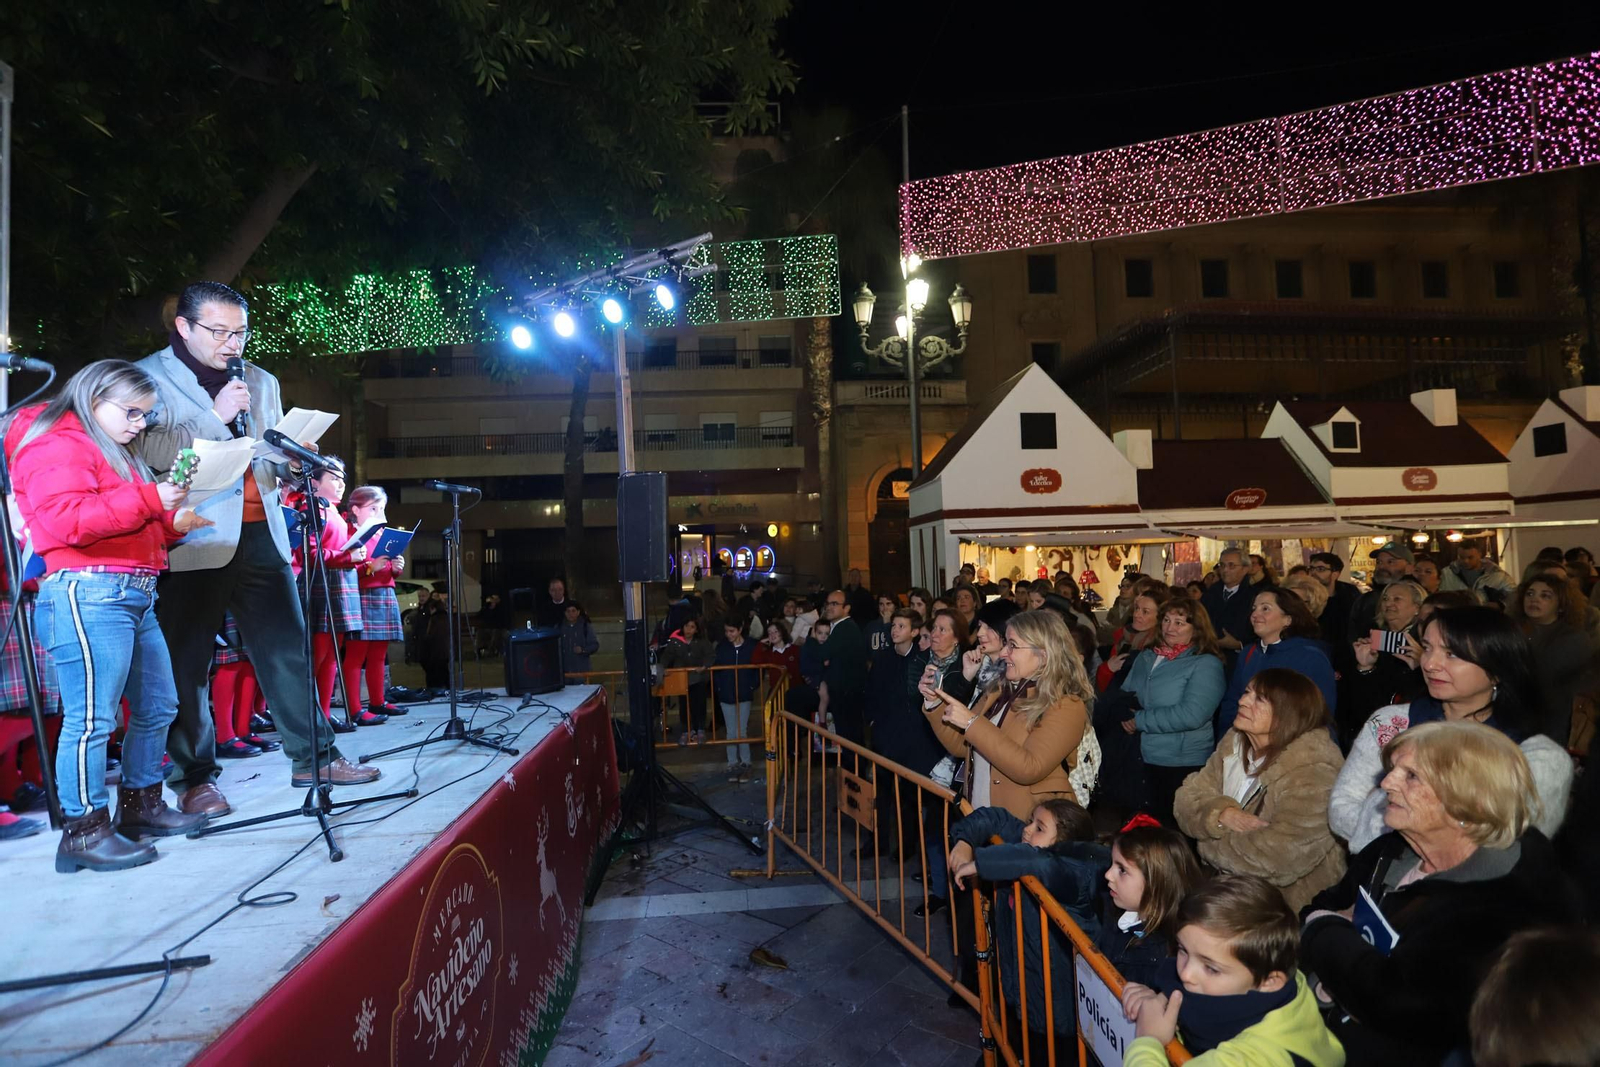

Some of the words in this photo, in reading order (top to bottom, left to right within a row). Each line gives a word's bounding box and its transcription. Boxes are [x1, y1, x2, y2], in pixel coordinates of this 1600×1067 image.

[708, 502, 759, 514] CaixaBank
[432, 882, 475, 945] MERCADO
[413, 917, 485, 1040] Navideño
[427, 938, 492, 1060] Artesano
